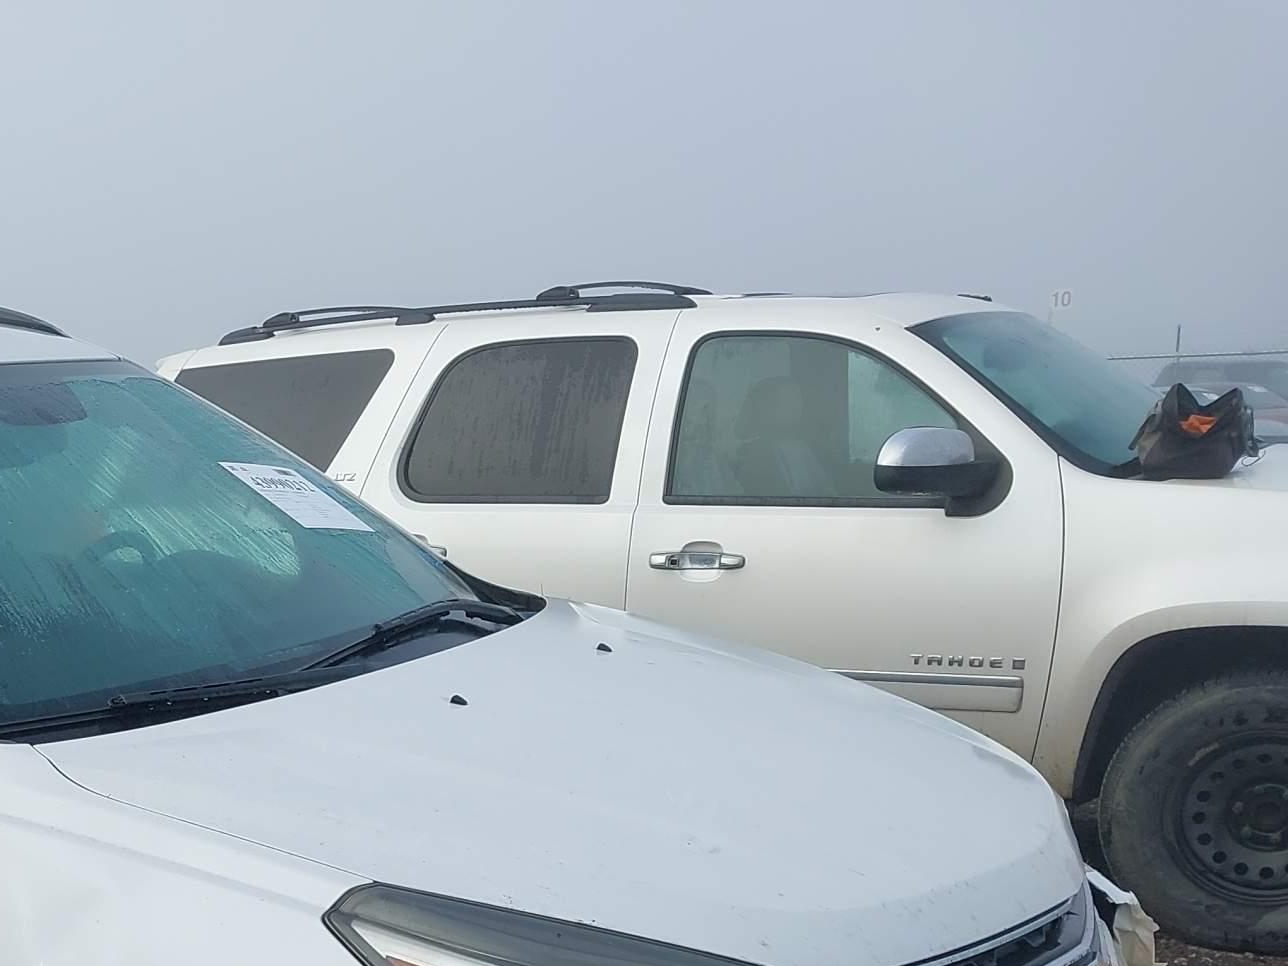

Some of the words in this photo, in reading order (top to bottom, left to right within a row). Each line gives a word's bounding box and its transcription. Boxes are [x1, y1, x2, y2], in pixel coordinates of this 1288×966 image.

[1052, 291, 1072, 307] 10
[335, 472, 357, 482] LTZ
[909, 653, 1004, 669] TAHOE
